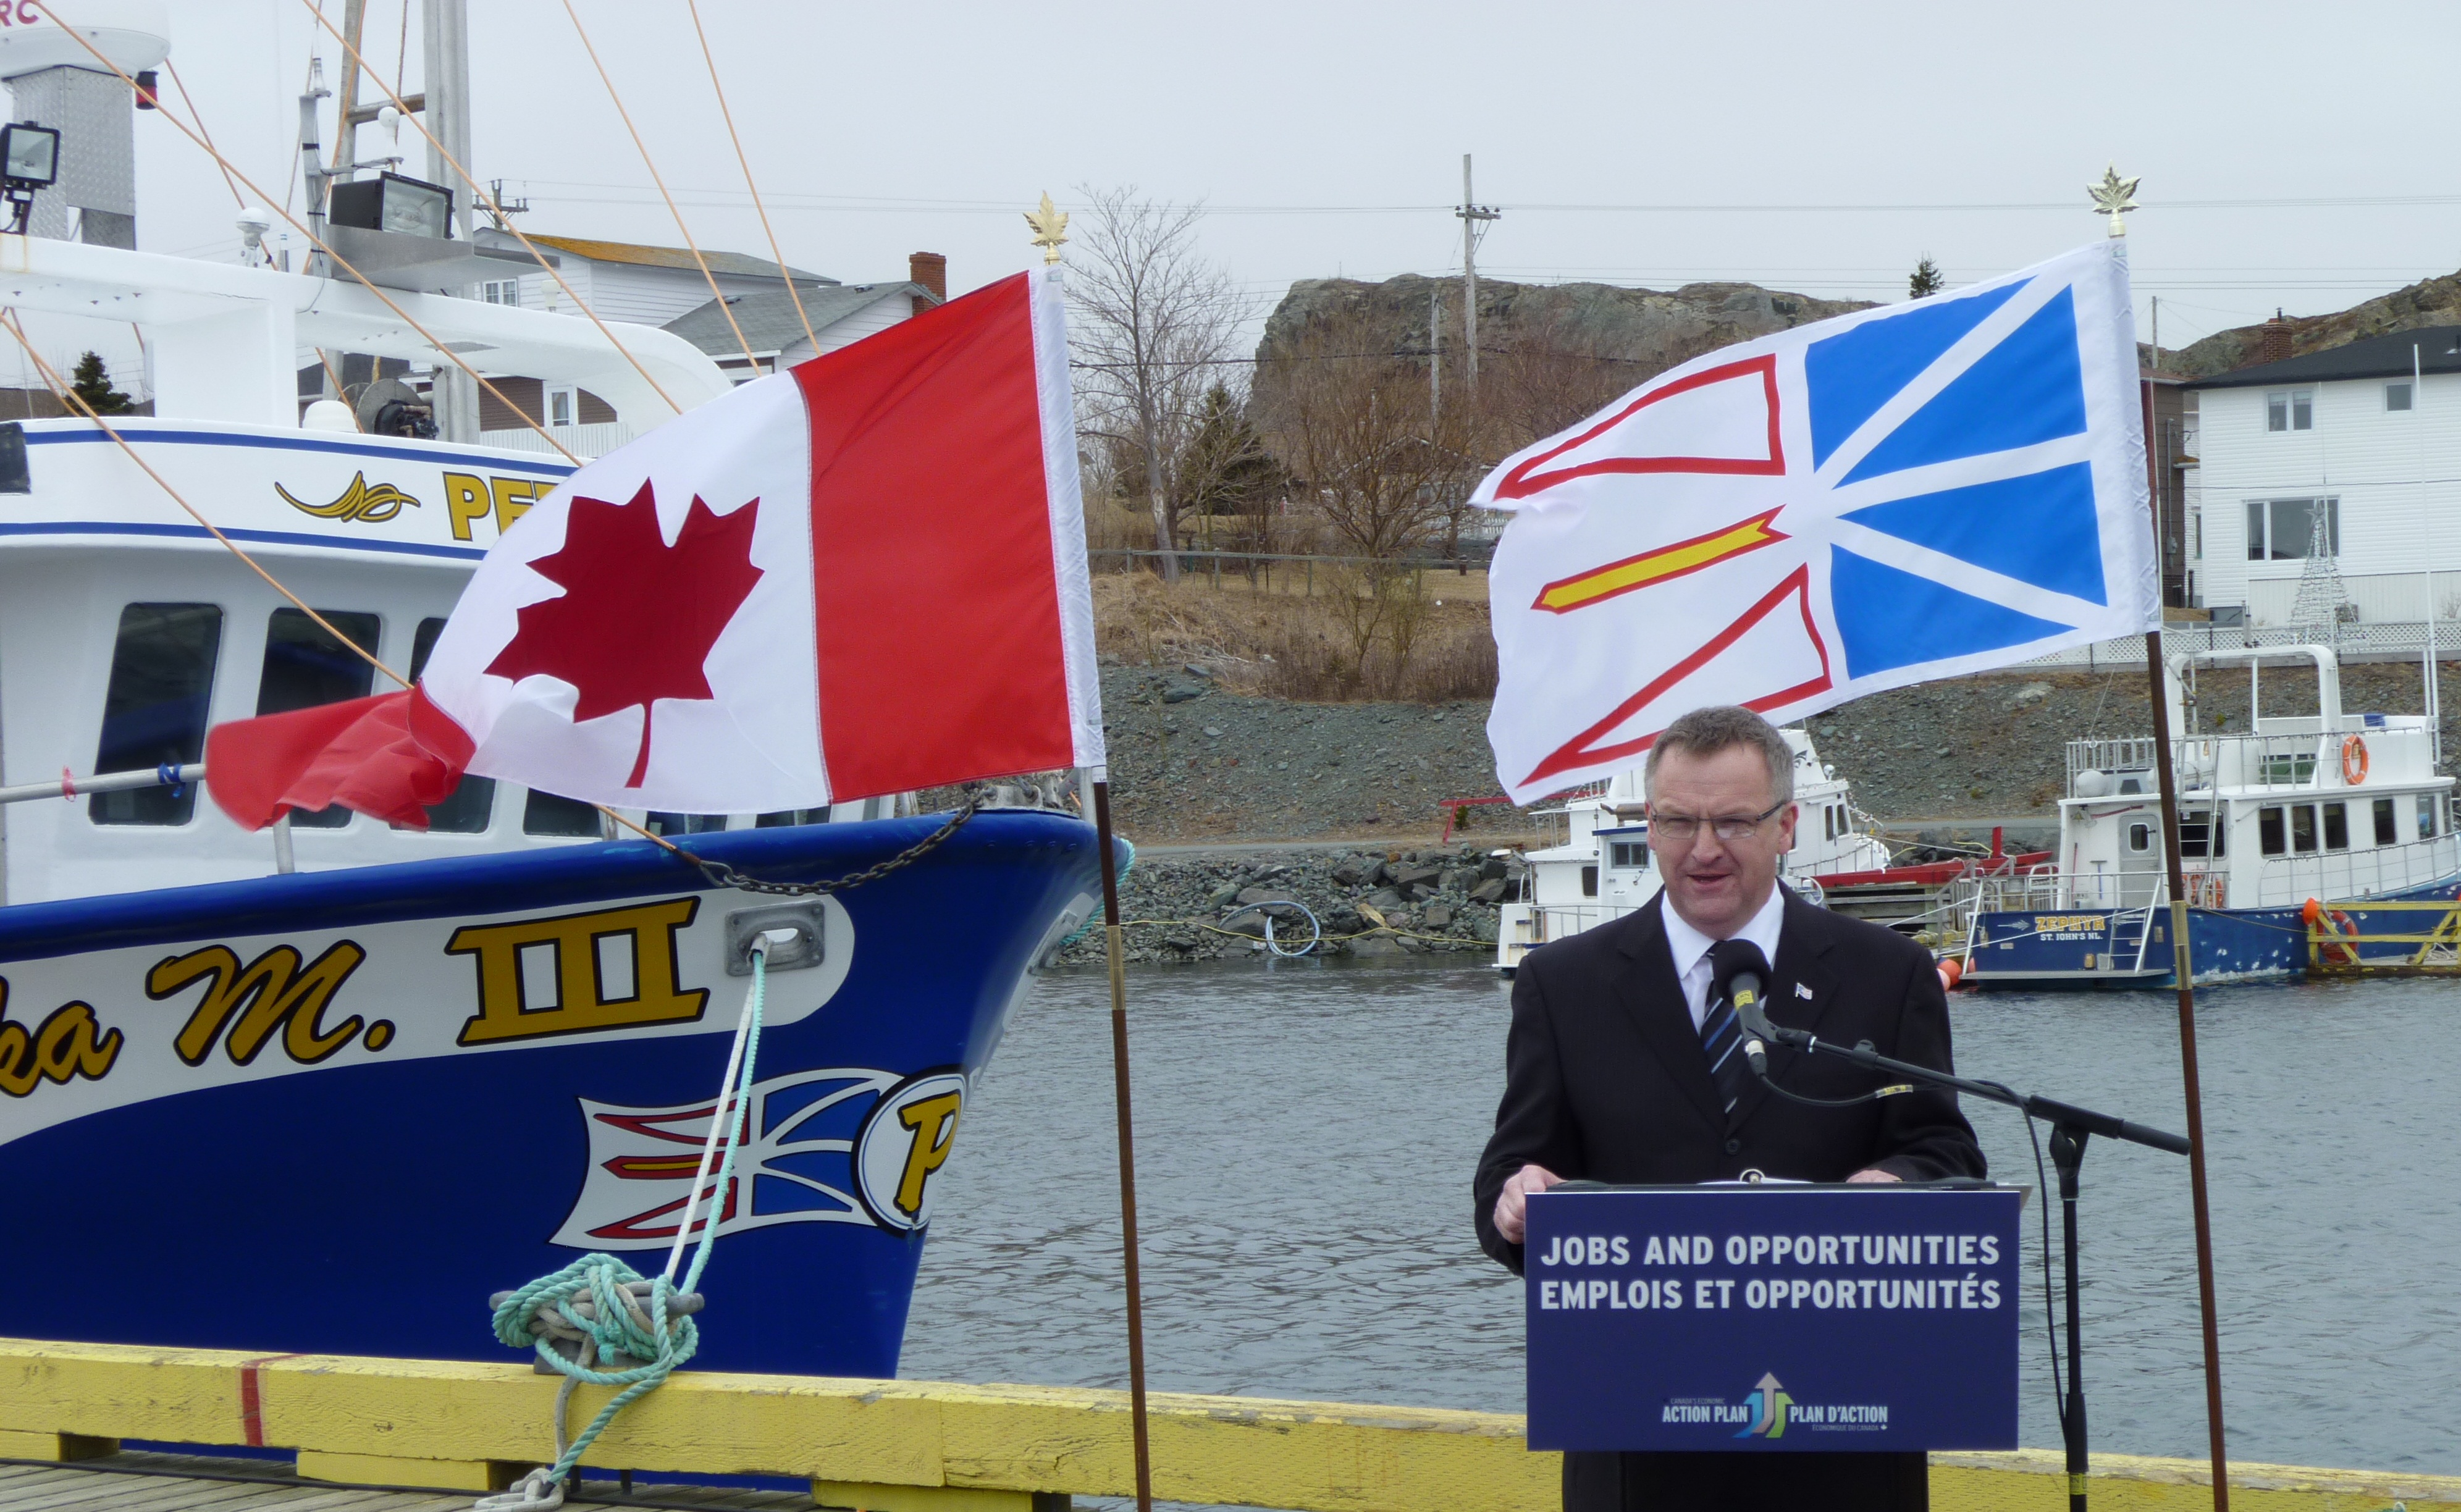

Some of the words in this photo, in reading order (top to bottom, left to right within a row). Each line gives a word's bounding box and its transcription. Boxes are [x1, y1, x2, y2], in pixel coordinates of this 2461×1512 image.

[442, 471, 560, 541] PE
[2035, 915, 2105, 931] ZEPHYR
[2056, 933, 2085, 941] JOHN'S
[2088, 932, 2103, 940] NL.
[145, 939, 396, 1067] M.
[444, 896, 710, 1047] III
[1541, 1236, 1630, 1266] JOBS
[1643, 1235, 1714, 1265] AND
[1725, 1235, 2000, 1265] OPPORTUNITIES
[1541, 1279, 1683, 1309] EMPLOIS
[1695, 1279, 1735, 1309] ET
[1745, 1272, 2001, 1309] OPPORTUNITÉS
[1662, 1406, 1710, 1422] ACTION
[1714, 1406, 1748, 1422] PLAN
[1790, 1406, 1824, 1422] PLAN
[1827, 1406, 1888, 1422] D'ACTION
